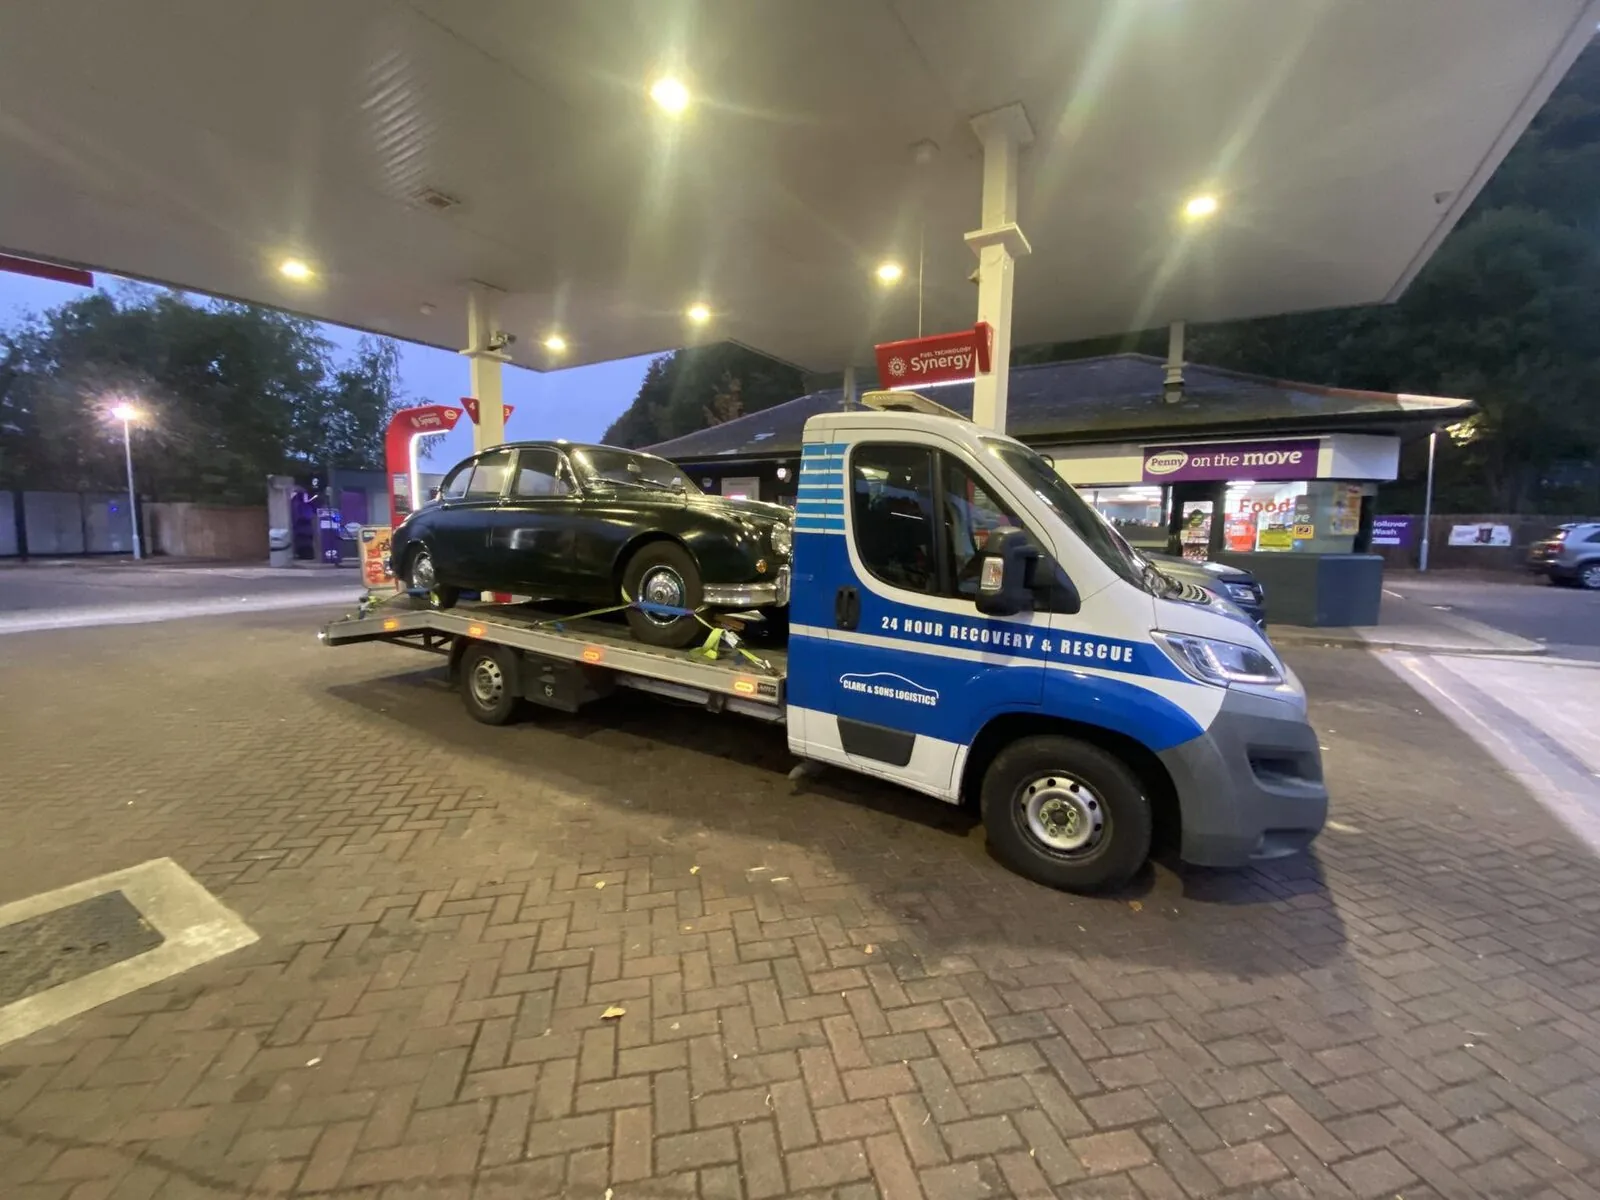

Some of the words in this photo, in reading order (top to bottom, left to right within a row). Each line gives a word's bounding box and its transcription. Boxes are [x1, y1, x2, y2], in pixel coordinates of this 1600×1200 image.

[911, 353, 972, 374] Synergy
[1151, 457, 1184, 467] Penny
[1191, 457, 1210, 467] on
[1215, 453, 1239, 466] the
[1242, 450, 1302, 465] move
[1239, 498, 1291, 513] Food
[881, 616, 898, 630] 24
[904, 619, 943, 636] HOUR
[950, 625, 1035, 649] RECOVERY
[1041, 639, 1052, 652] &
[1060, 639, 1133, 663] RESCUE
[843, 679, 867, 692] CLARK
[867, 685, 873, 694] &
[874, 685, 894, 698] SONS
[895, 689, 937, 706] LOGISTICS
